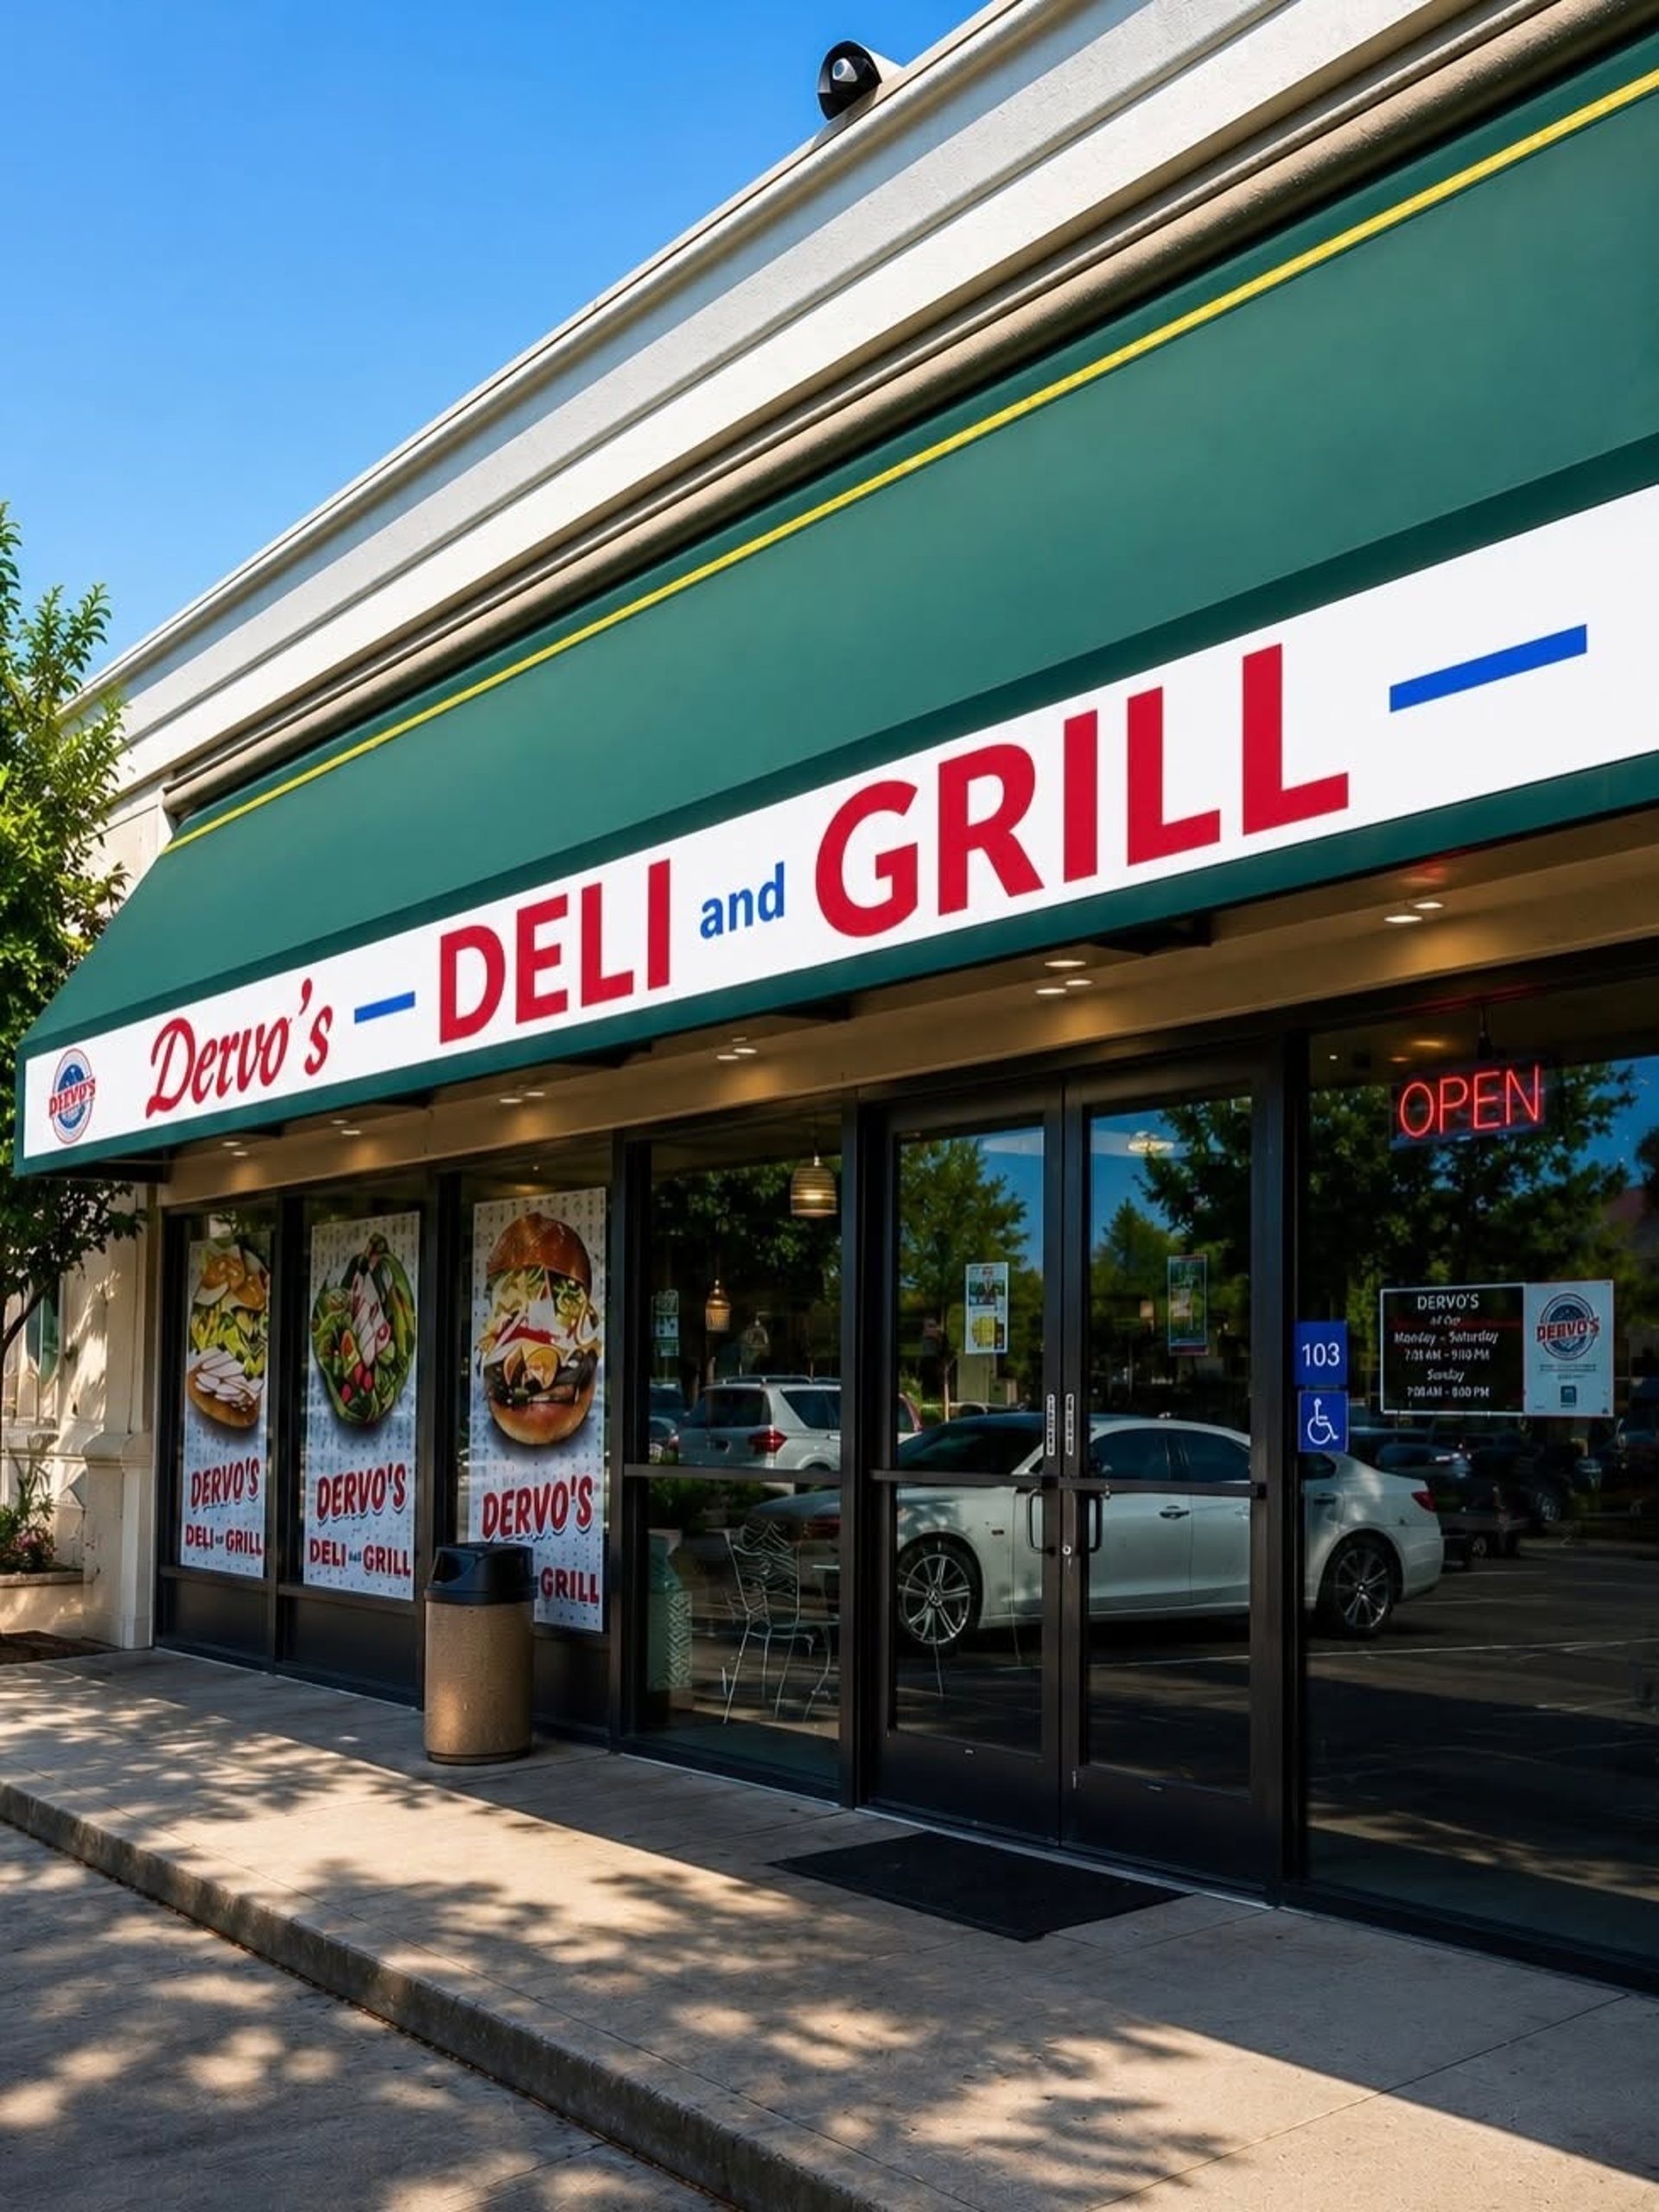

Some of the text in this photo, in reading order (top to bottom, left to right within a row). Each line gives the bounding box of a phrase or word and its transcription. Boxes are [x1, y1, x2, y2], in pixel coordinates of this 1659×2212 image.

[145, 643, 1349, 1118] Dervo's DELI and GRILL
[1399, 1064, 1542, 1138] OPEN
[1417, 1293, 1480, 1311] DERVO'S
[1394, 1332, 1436, 1347] Monday
[1449, 1329, 1498, 1344] Saturday
[1536, 1315, 1600, 1344] DERVO'S
[1301, 1342, 1340, 1367] 103
[191, 1457, 260, 1509] DERVO'S
[316, 1462, 406, 1522] DERVO'S
[480, 1473, 594, 1541] DERVO'S
[186, 1523, 263, 1556] DELI GRILL
[309, 1538, 411, 1577] DELI GRILL
[540, 1567, 600, 1605] GRILL
